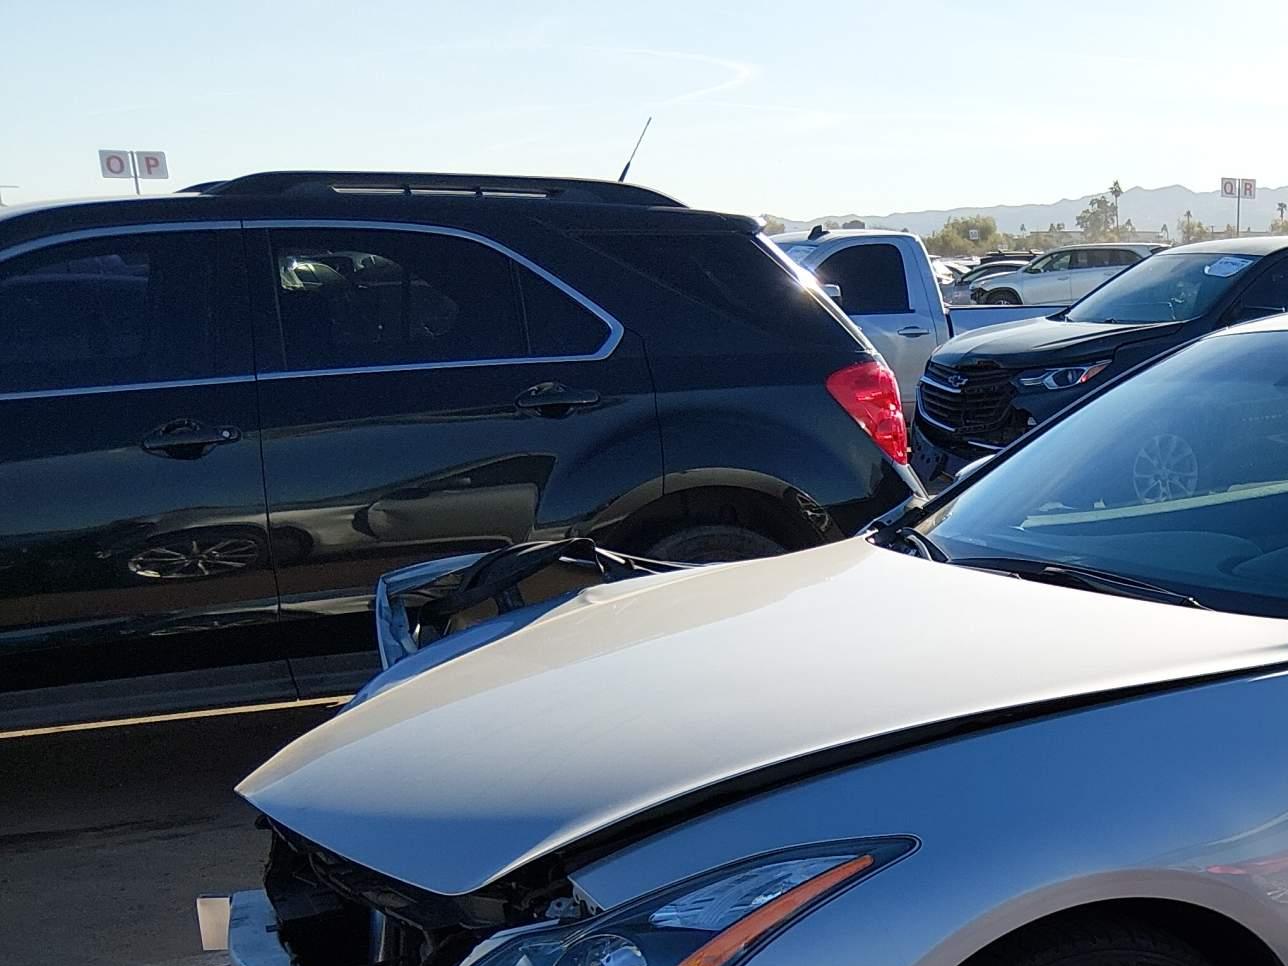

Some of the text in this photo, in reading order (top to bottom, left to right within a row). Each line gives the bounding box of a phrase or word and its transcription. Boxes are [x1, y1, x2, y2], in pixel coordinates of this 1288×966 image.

[106, 155, 159, 175] O P
[1223, 181, 1253, 197] Q R
